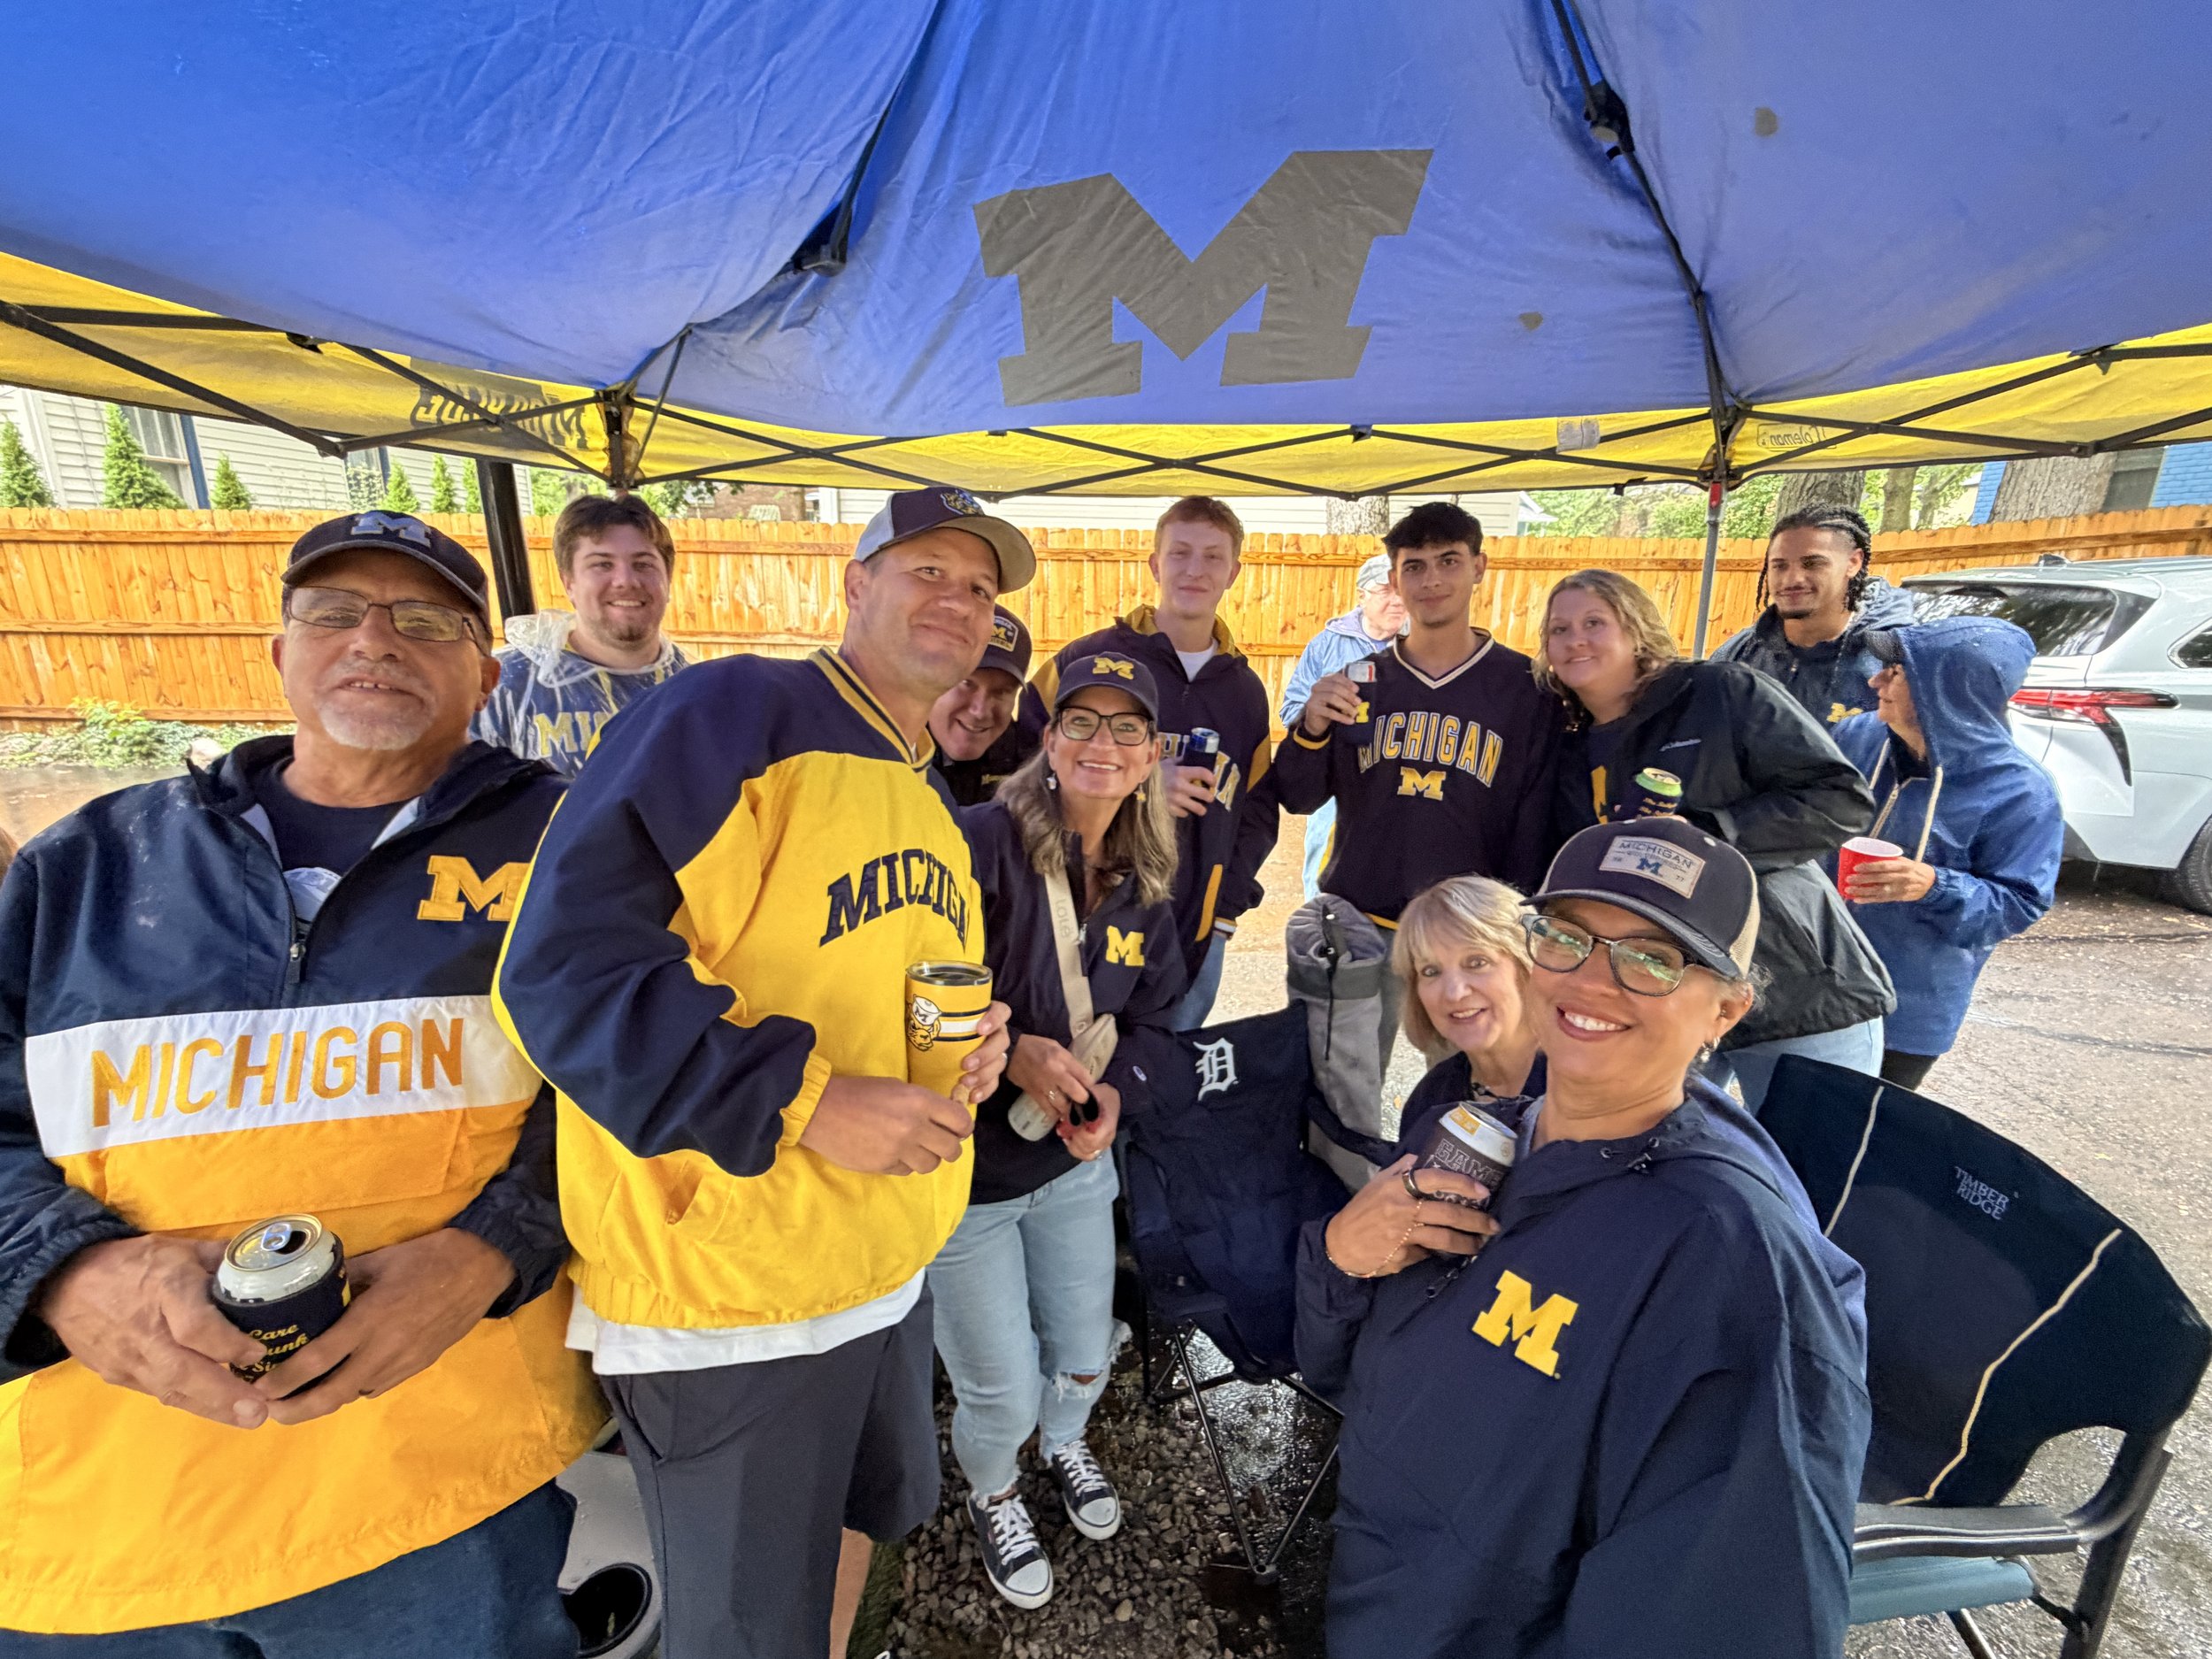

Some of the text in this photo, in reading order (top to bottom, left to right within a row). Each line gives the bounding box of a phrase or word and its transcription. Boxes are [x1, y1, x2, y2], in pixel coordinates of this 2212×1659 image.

[973, 149, 1433, 407] M
[350, 511, 432, 548] M
[1092, 657, 1134, 680] M
[1357, 710, 1503, 787] MICHIGAN
[1397, 766, 1446, 801] M
[1619, 842, 1694, 868] MICHIGAN
[1636, 857, 1663, 875] M
[417, 856, 529, 921] M
[1105, 926, 1145, 966] M
[91, 1018, 464, 1127] MICHIGAN
[1193, 1037, 1238, 1102] D
[1955, 1166, 2009, 1210] TIMBER
[1956, 1182, 2004, 1220] RIDGE
[1471, 1269, 1579, 1377] M
